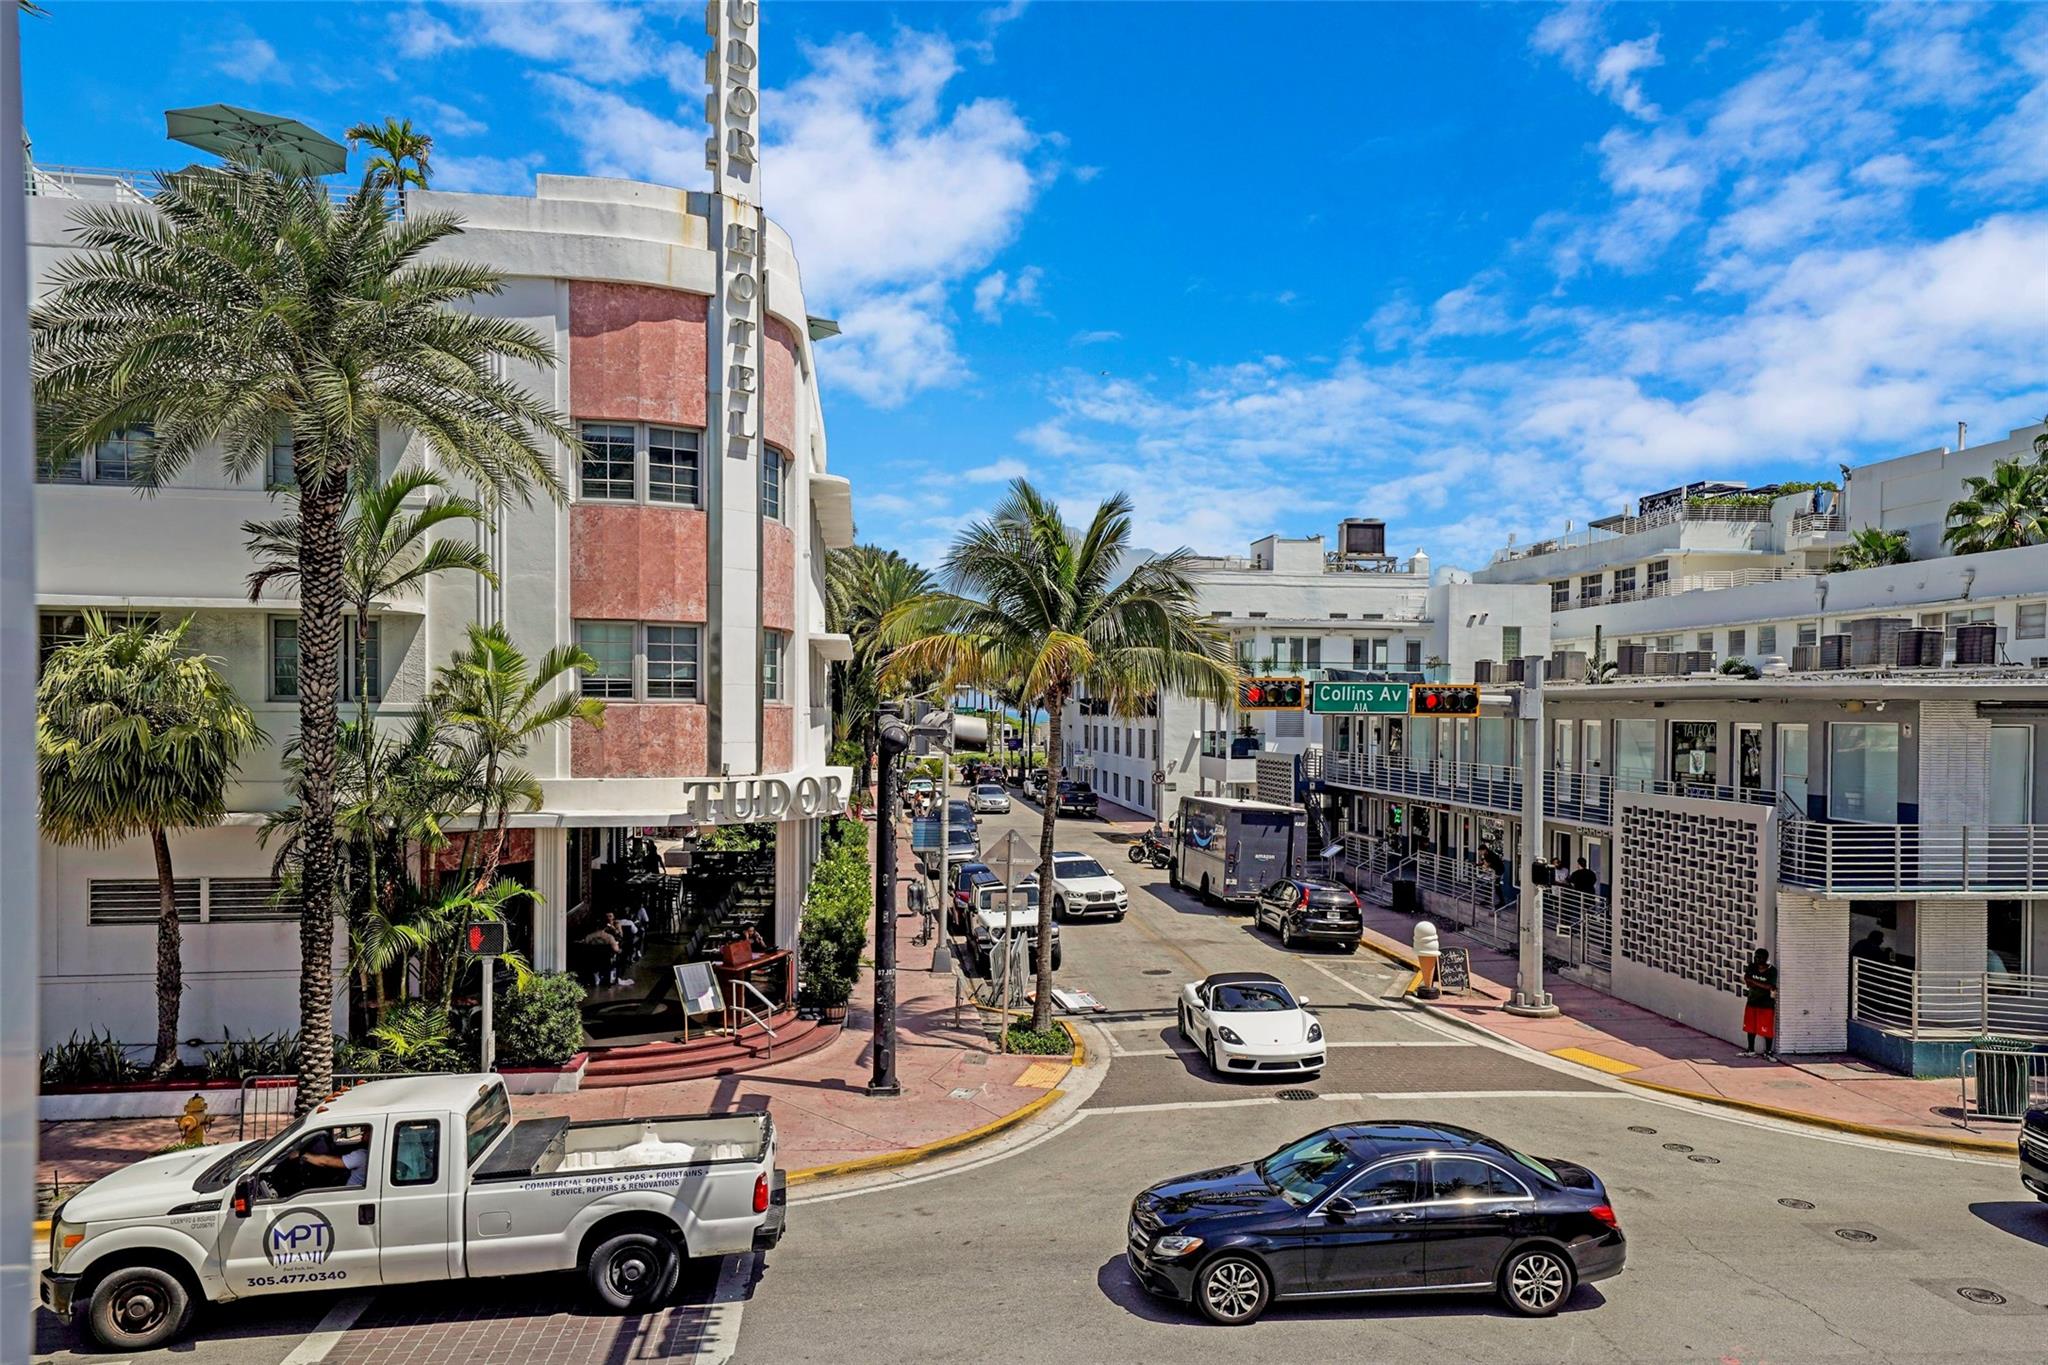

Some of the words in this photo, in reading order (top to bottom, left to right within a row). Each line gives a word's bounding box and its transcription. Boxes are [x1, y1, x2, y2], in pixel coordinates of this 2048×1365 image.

[728, 223, 758, 440] HOTEL
[1320, 685, 1374, 701] Collins
[1379, 686, 1402, 701] Av
[1684, 723, 1716, 738] TATTOO
[683, 775, 843, 823] TUDOR
[524, 1178, 582, 1191] COMMERCIAL
[585, 1176, 614, 1186] POOLS
[623, 1173, 646, 1183] SPAS
[656, 1168, 703, 1180] FOUNTAINS
[551, 1185, 585, 1197] SERVICE,
[586, 1184, 619, 1194] REPAIRS
[628, 1178, 680, 1191] RENOVATIONS
[273, 1222, 332, 1250] MPT
[274, 1250, 323, 1265] MIAMI
[247, 1270, 347, 1287] 305.477.0340
